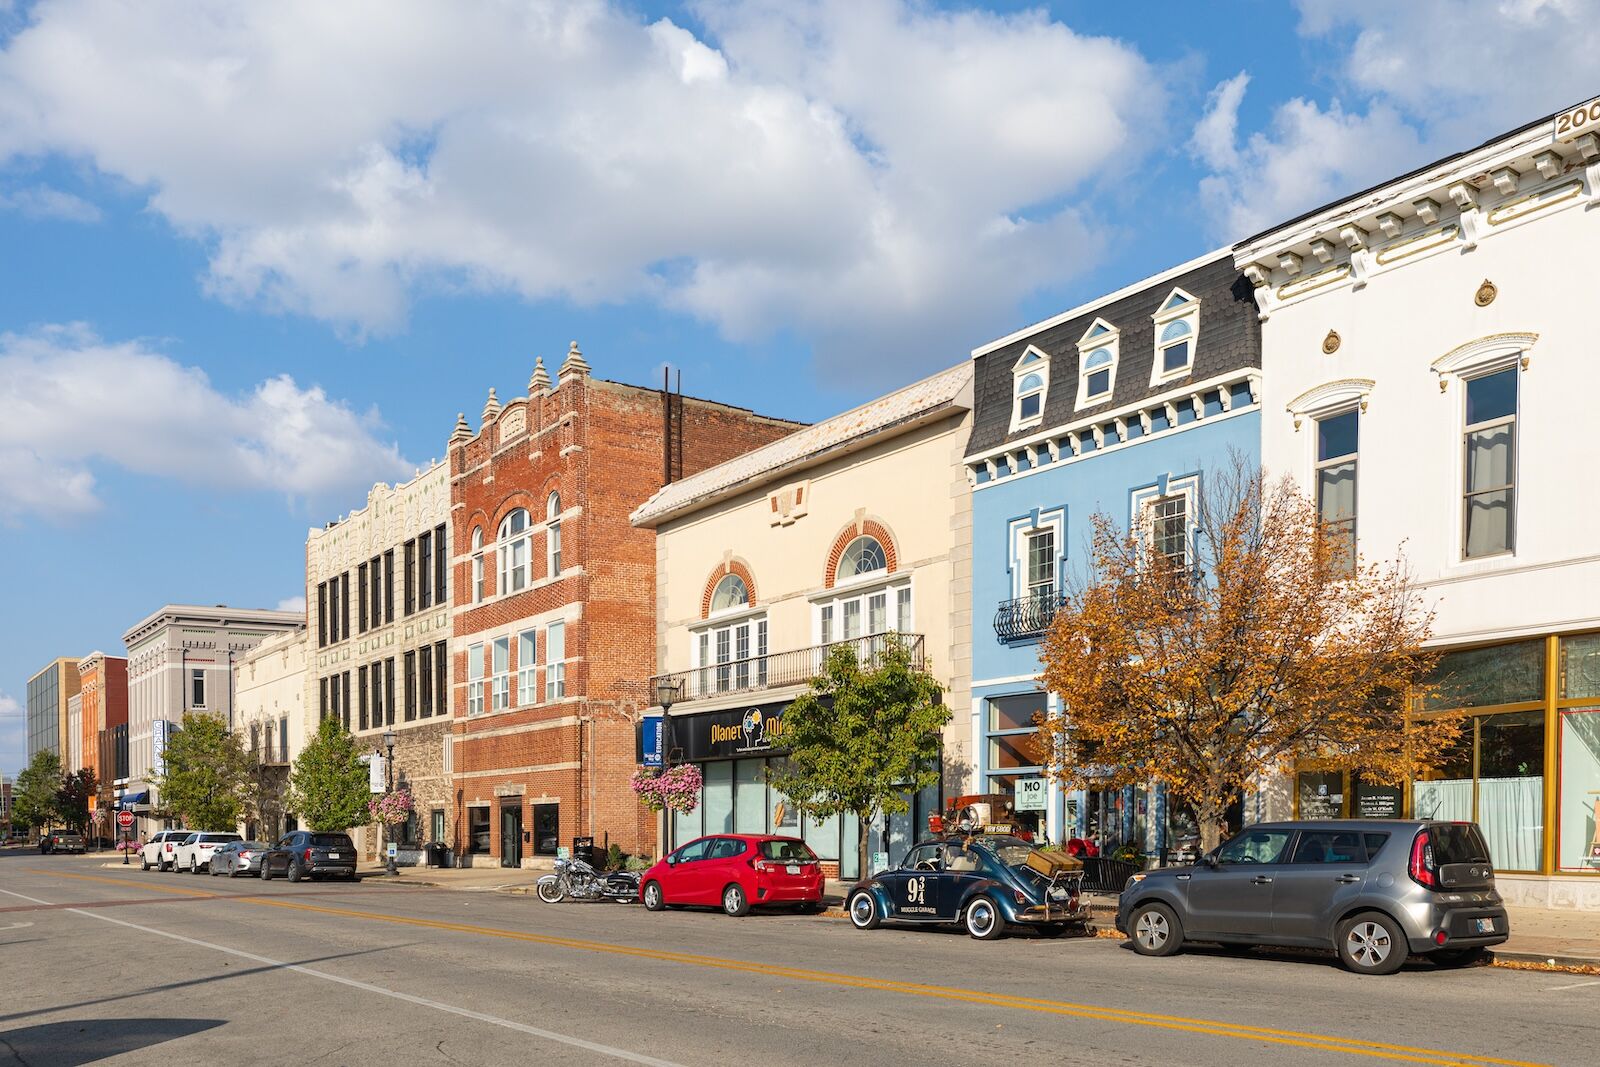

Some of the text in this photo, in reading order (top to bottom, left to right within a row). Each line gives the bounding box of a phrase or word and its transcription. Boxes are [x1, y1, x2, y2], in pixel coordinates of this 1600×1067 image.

[711, 724, 742, 745] Planet
[1024, 781, 1040, 791] MO
[1027, 791, 1037, 801] joe
[918, 906, 936, 914] GARAGE
